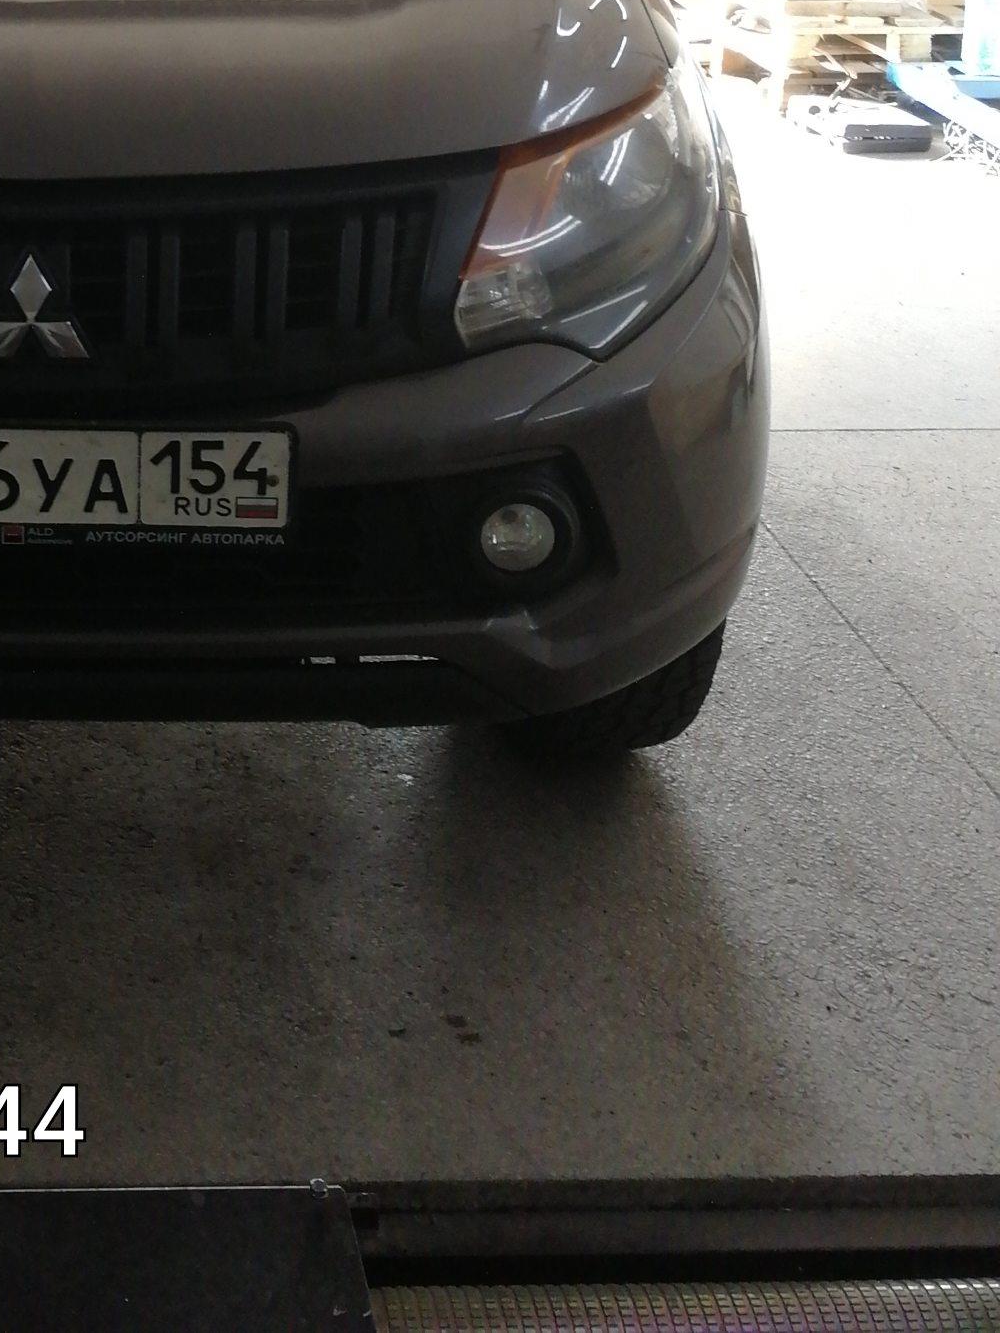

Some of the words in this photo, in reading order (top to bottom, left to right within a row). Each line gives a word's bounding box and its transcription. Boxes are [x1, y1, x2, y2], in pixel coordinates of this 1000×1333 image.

[150, 441, 268, 495] 154
[174, 497, 232, 517] RUS
[27, 528, 55, 537] ALD
[85, 532, 187, 546] АУТСОРСИНГ
[191, 534, 285, 546] АВТОПАРКА
